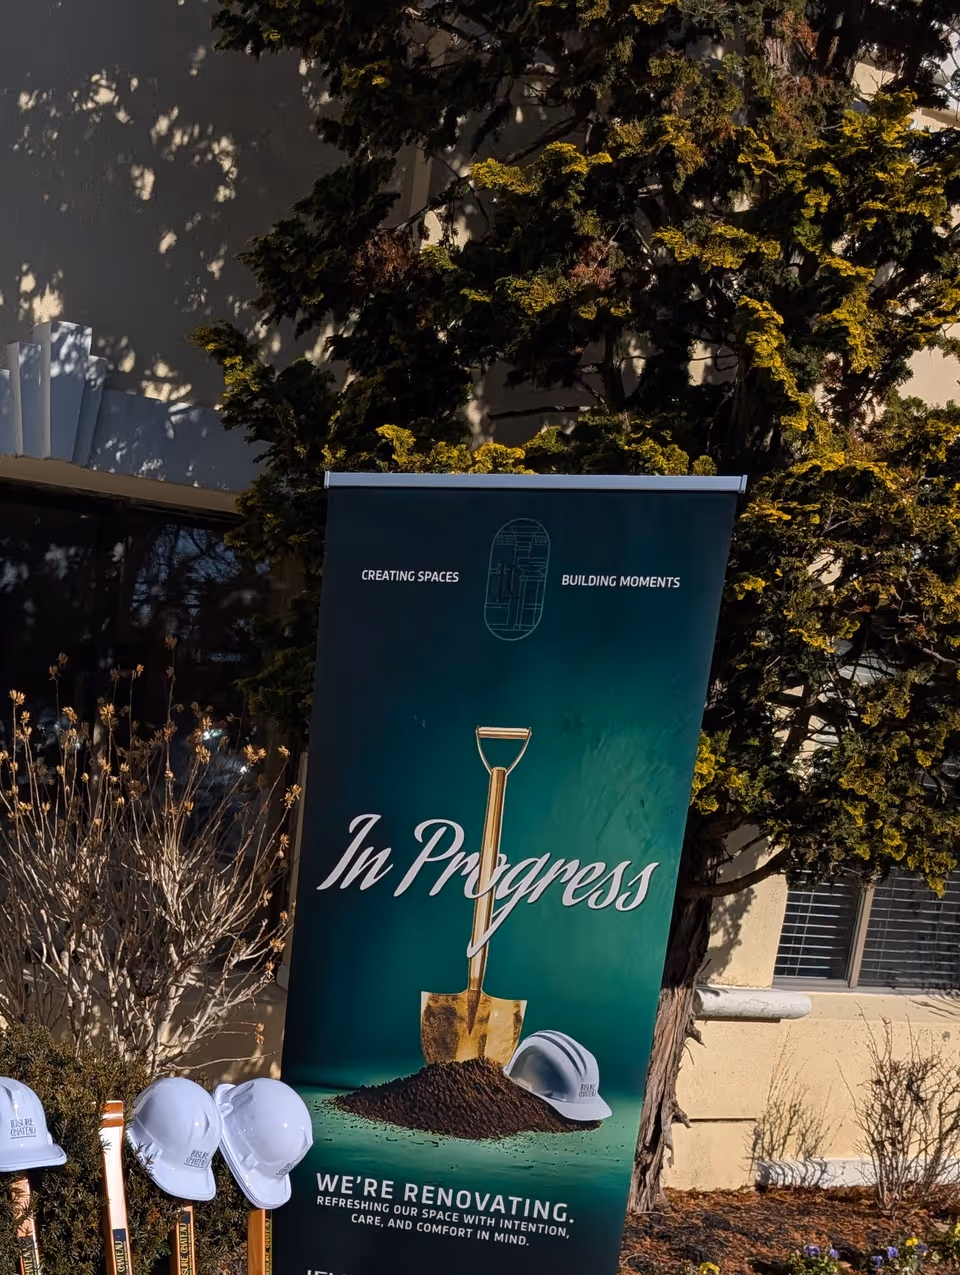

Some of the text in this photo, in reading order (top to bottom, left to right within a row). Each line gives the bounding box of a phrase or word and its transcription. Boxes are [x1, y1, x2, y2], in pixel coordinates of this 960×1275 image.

[361, 569, 459, 582] CREATING SPACES
[561, 574, 680, 588] BUILDING MOMENTS
[317, 813, 660, 959] In Progress
[316, 1172, 574, 1224] WE’RE RENOVATING.
[316, 1195, 570, 1239] REFRESHING OUR SPACE WITH INTENTION,
[351, 1213, 530, 1246] CARE, AND COMFORT IN MIND.
[115, 1240, 126, 1273] CHATEAU
